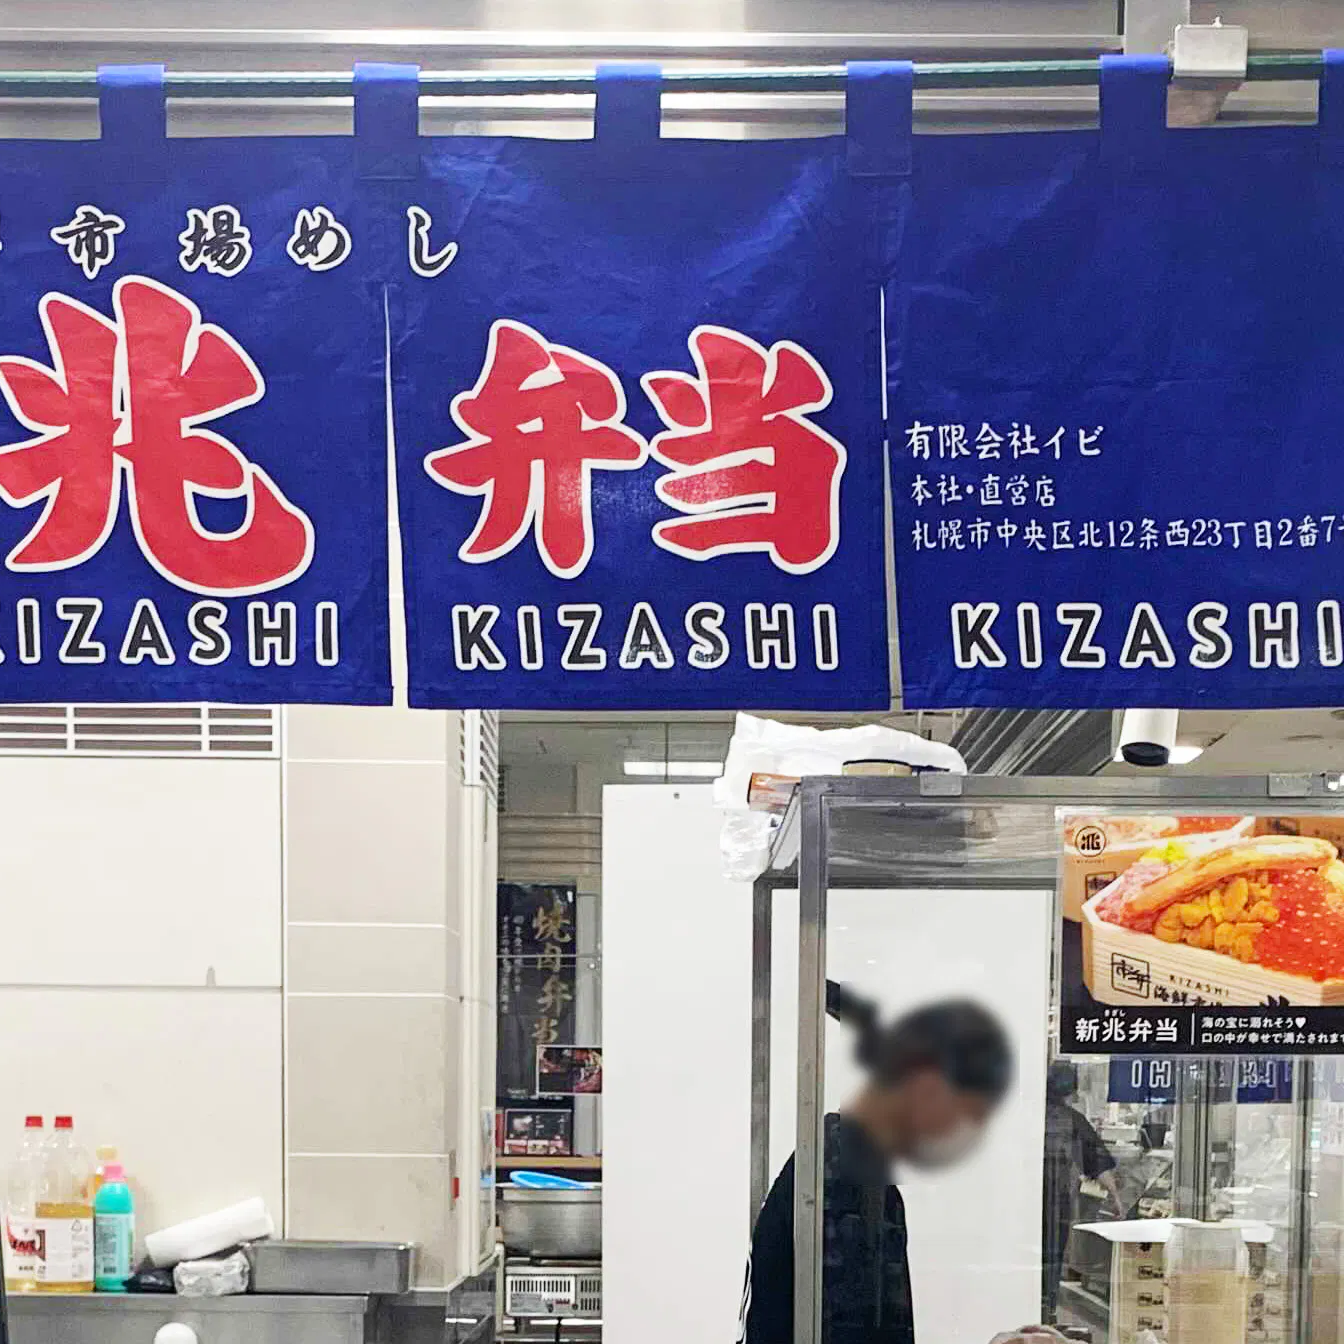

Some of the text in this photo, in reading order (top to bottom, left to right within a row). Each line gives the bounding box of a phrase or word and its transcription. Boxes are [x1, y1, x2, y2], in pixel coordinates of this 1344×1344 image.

[423, 317, 848, 578] 弁当
[904, 421, 1104, 461] 有限会社イビ
[910, 473, 1057, 508] 本社・直営店
[451, 600, 840, 671] KIZASHI
[950, 600, 1344, 670] KIZASHI
[1075, 1017, 1179, 1043] 新兆弁当
